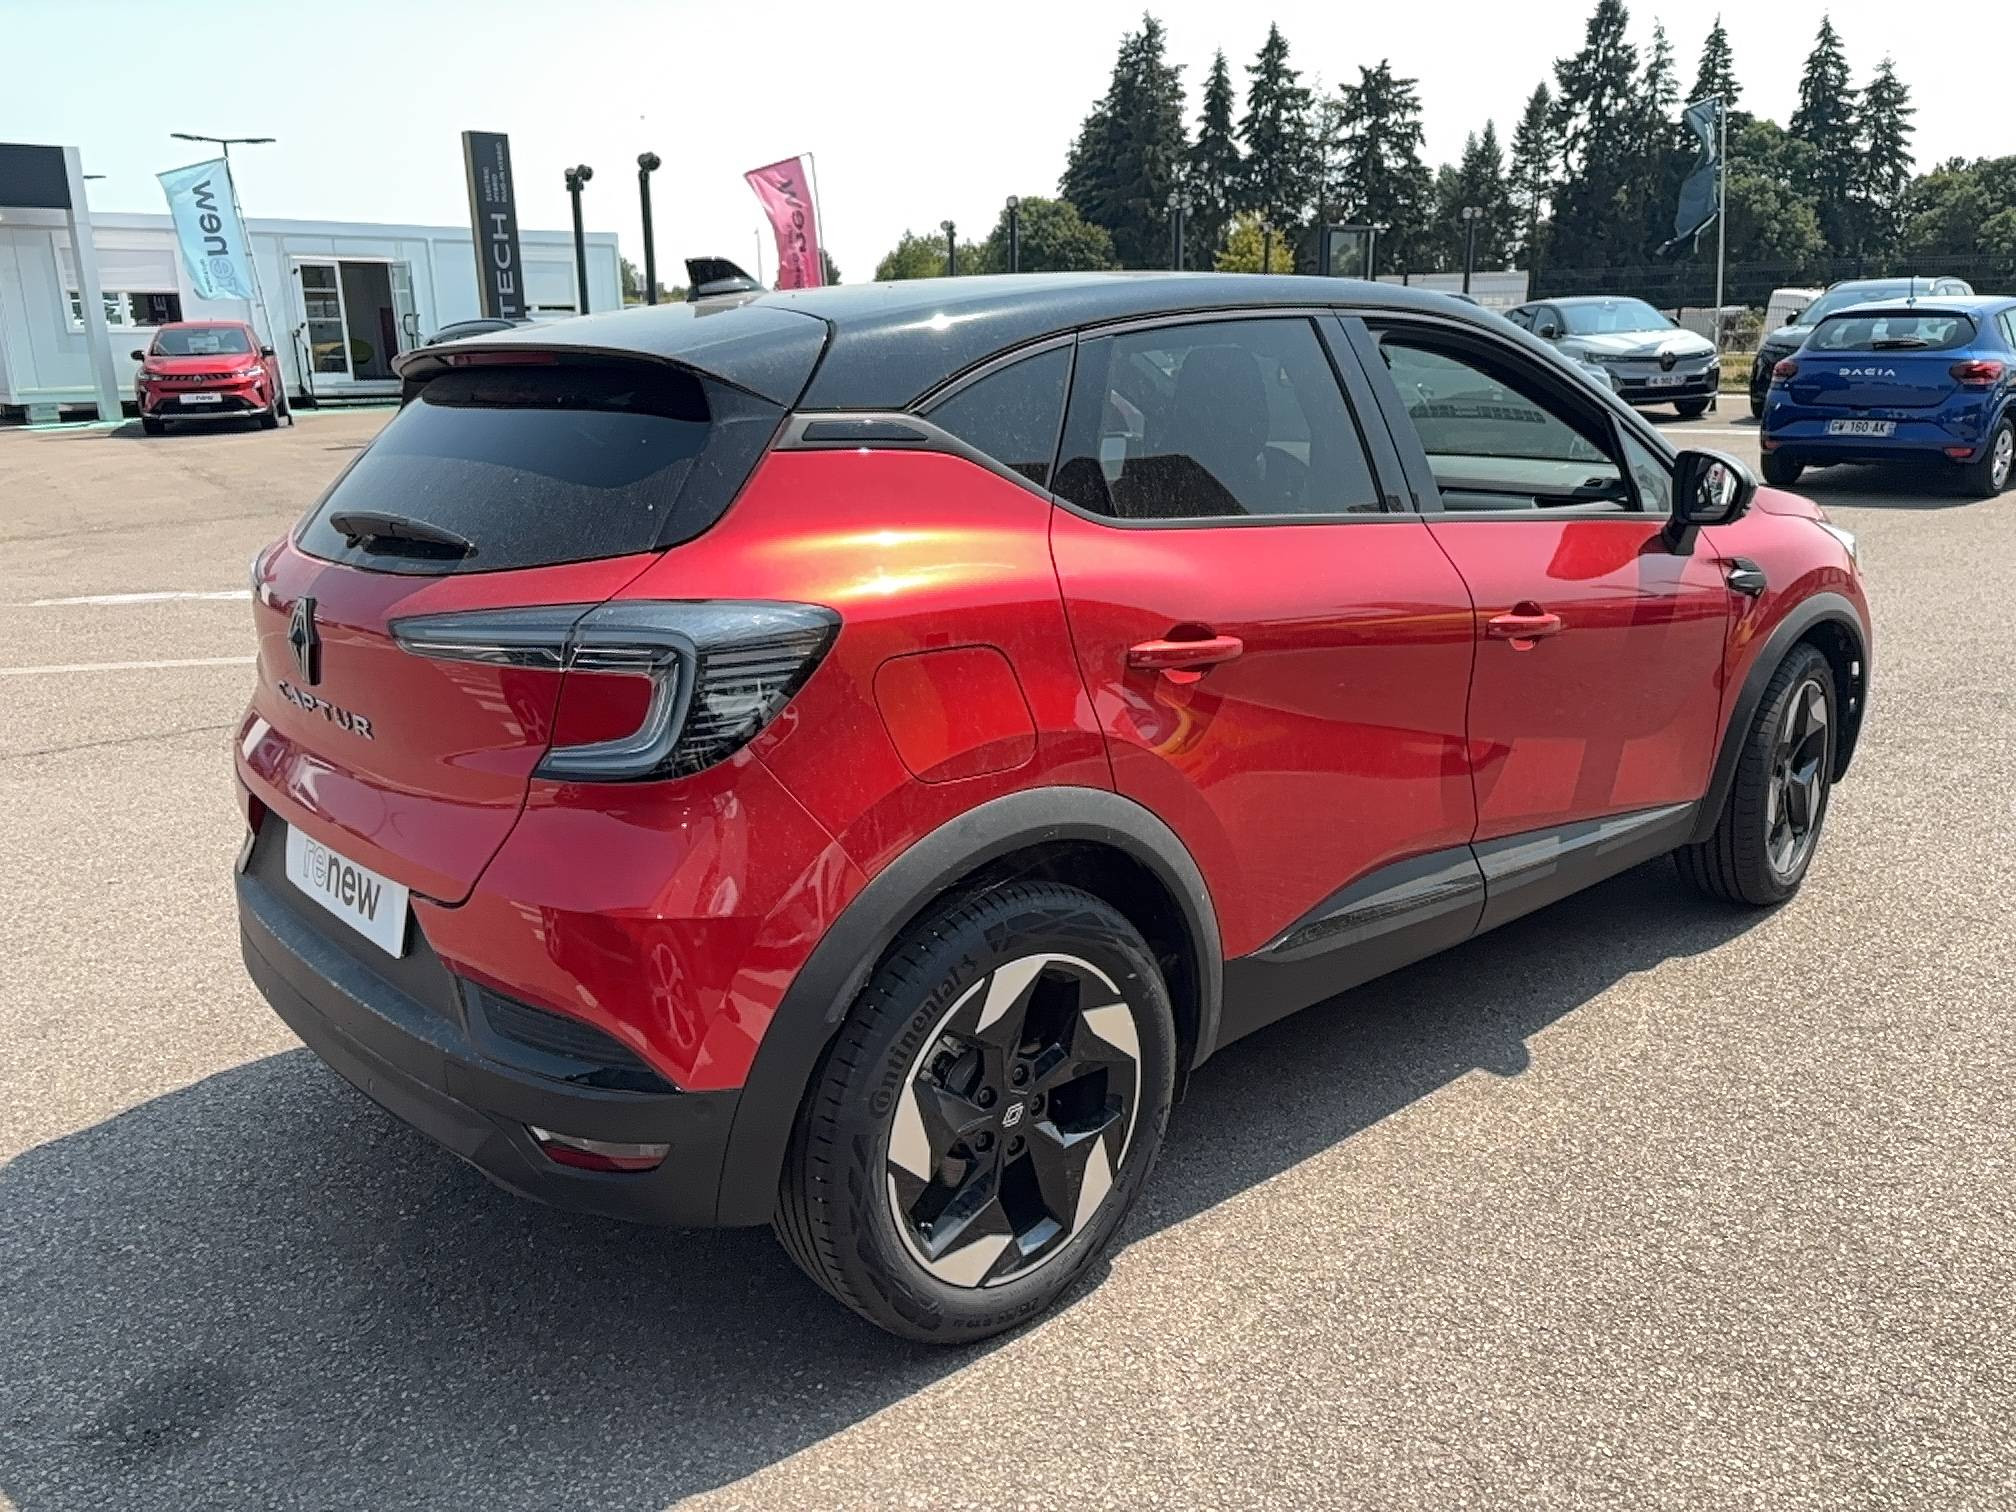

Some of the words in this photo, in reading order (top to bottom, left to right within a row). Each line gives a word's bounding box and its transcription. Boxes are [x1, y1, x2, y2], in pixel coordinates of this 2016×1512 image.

[1839, 367, 1896, 376] DACIA
[278, 680, 375, 741] CAPTUR
[303, 839, 382, 922] renew
[869, 967, 962, 1119] Continental
